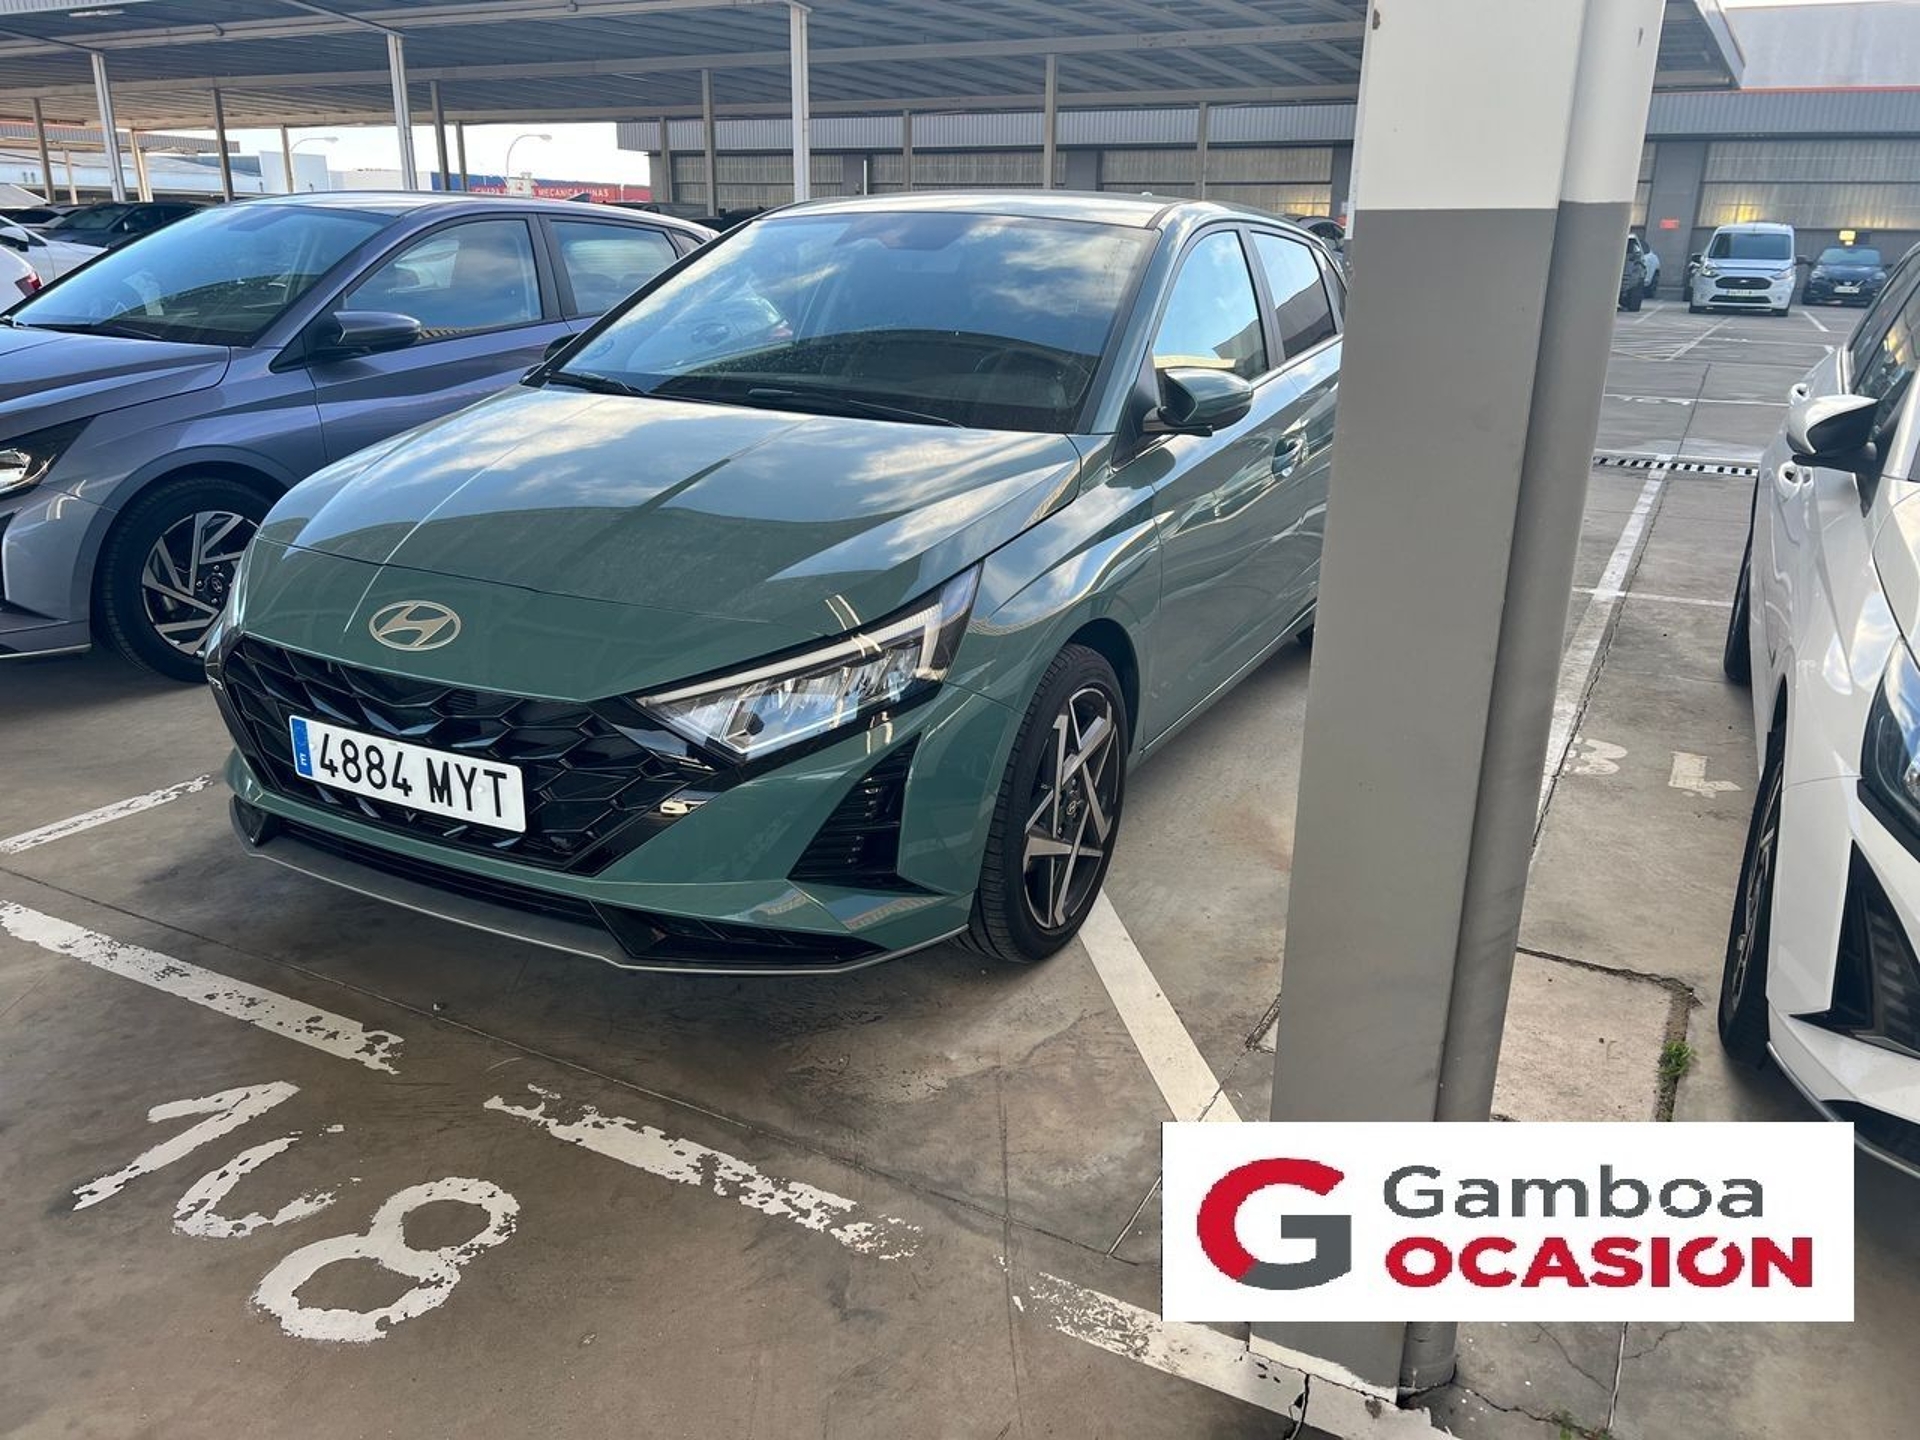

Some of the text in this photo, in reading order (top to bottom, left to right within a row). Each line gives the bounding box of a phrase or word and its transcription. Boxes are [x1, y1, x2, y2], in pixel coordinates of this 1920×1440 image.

[538, 188, 579, 198] MECANICA
[299, 753, 307, 766] E
[319, 733, 508, 818] 4884 MYT
